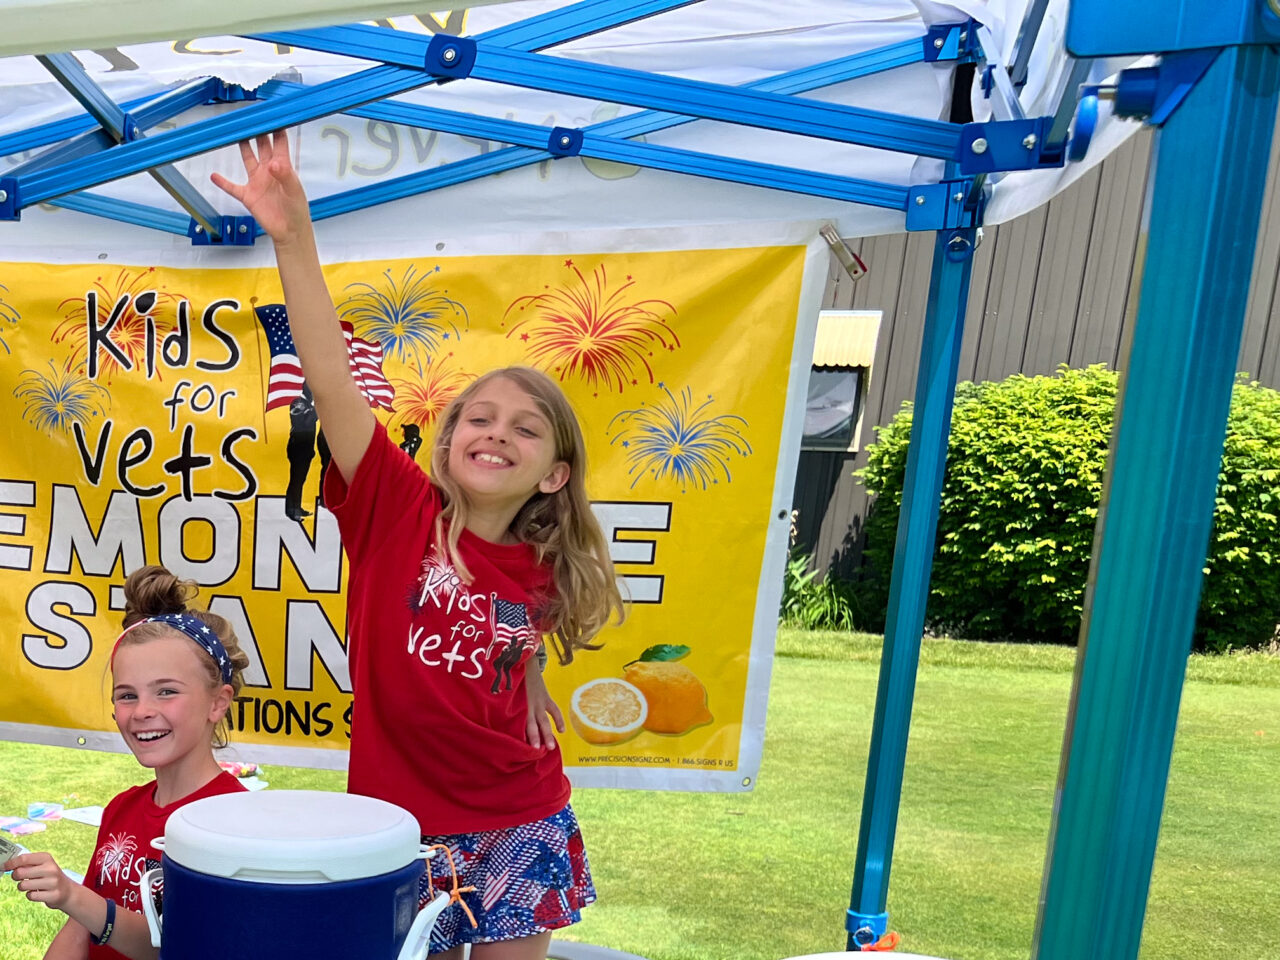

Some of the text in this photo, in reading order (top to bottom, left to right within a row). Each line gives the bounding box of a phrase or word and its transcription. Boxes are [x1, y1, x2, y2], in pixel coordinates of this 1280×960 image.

[87, 291, 239, 379] Kids
[164, 381, 236, 431] for
[419, 567, 486, 622] Kids
[450, 620, 484, 642] for
[101, 850, 146, 887] Kids
